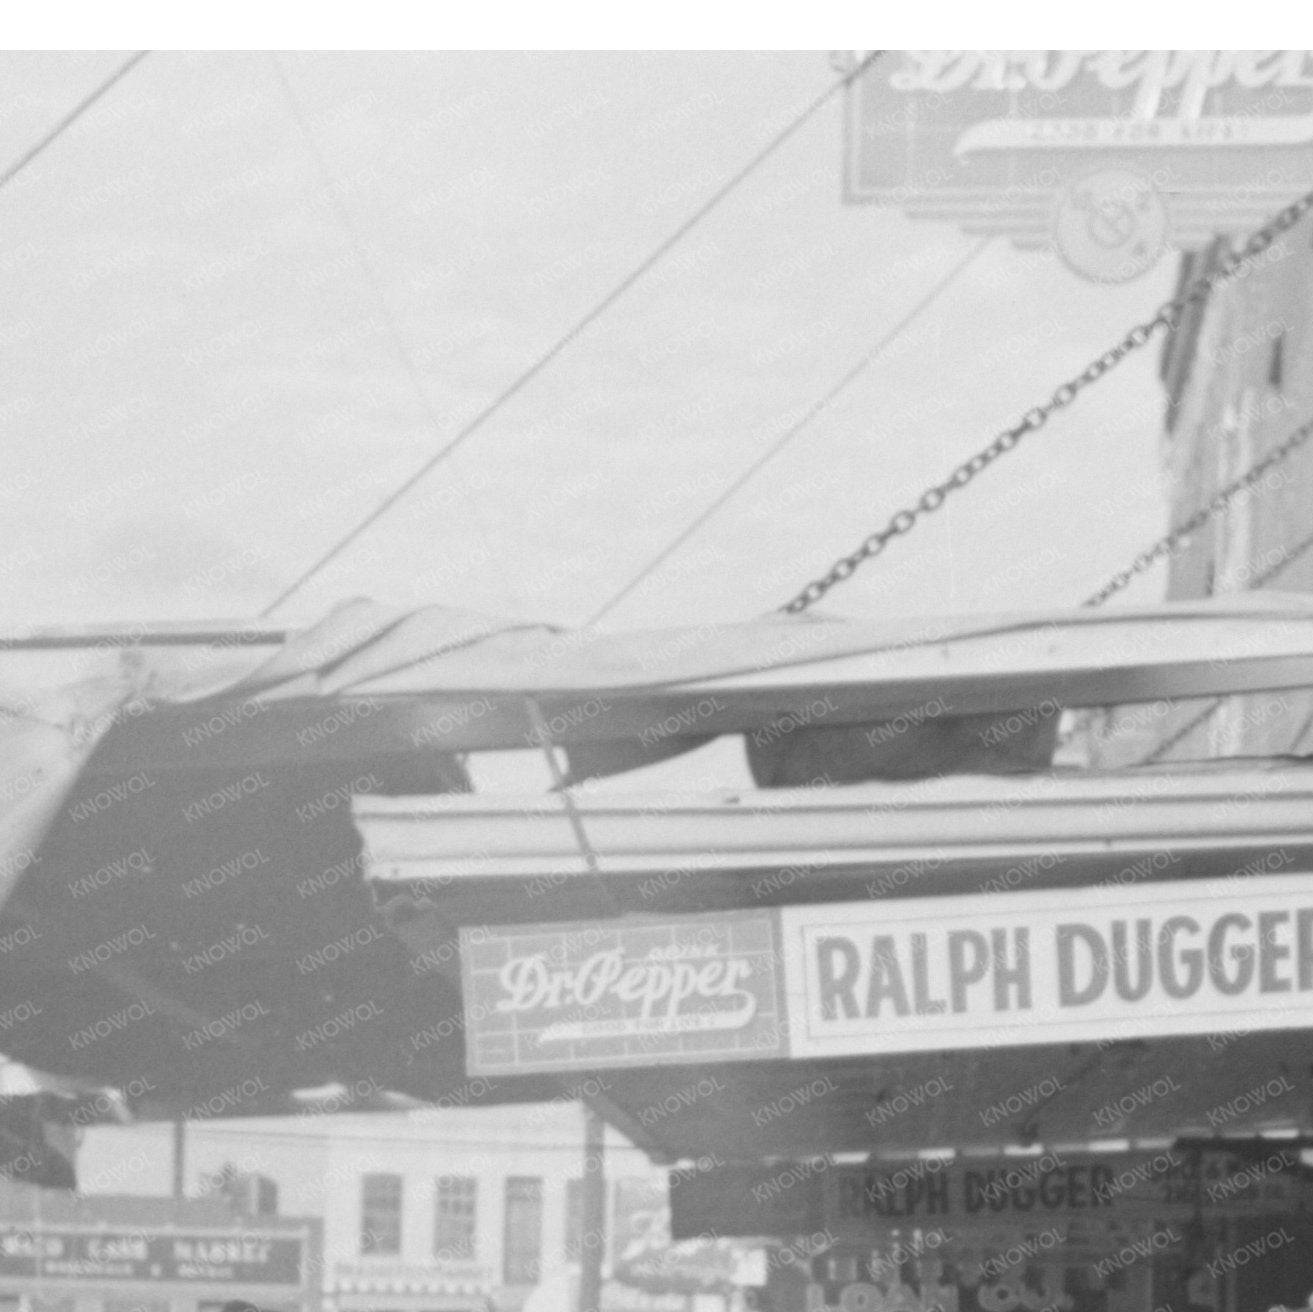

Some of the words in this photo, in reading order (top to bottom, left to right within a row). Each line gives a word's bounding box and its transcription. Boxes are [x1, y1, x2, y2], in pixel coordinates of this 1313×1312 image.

[815, 925, 1033, 1022] RALPH
[839, 1171, 949, 1219] RALPH
[964, 1163, 1115, 1214] DUGGER
